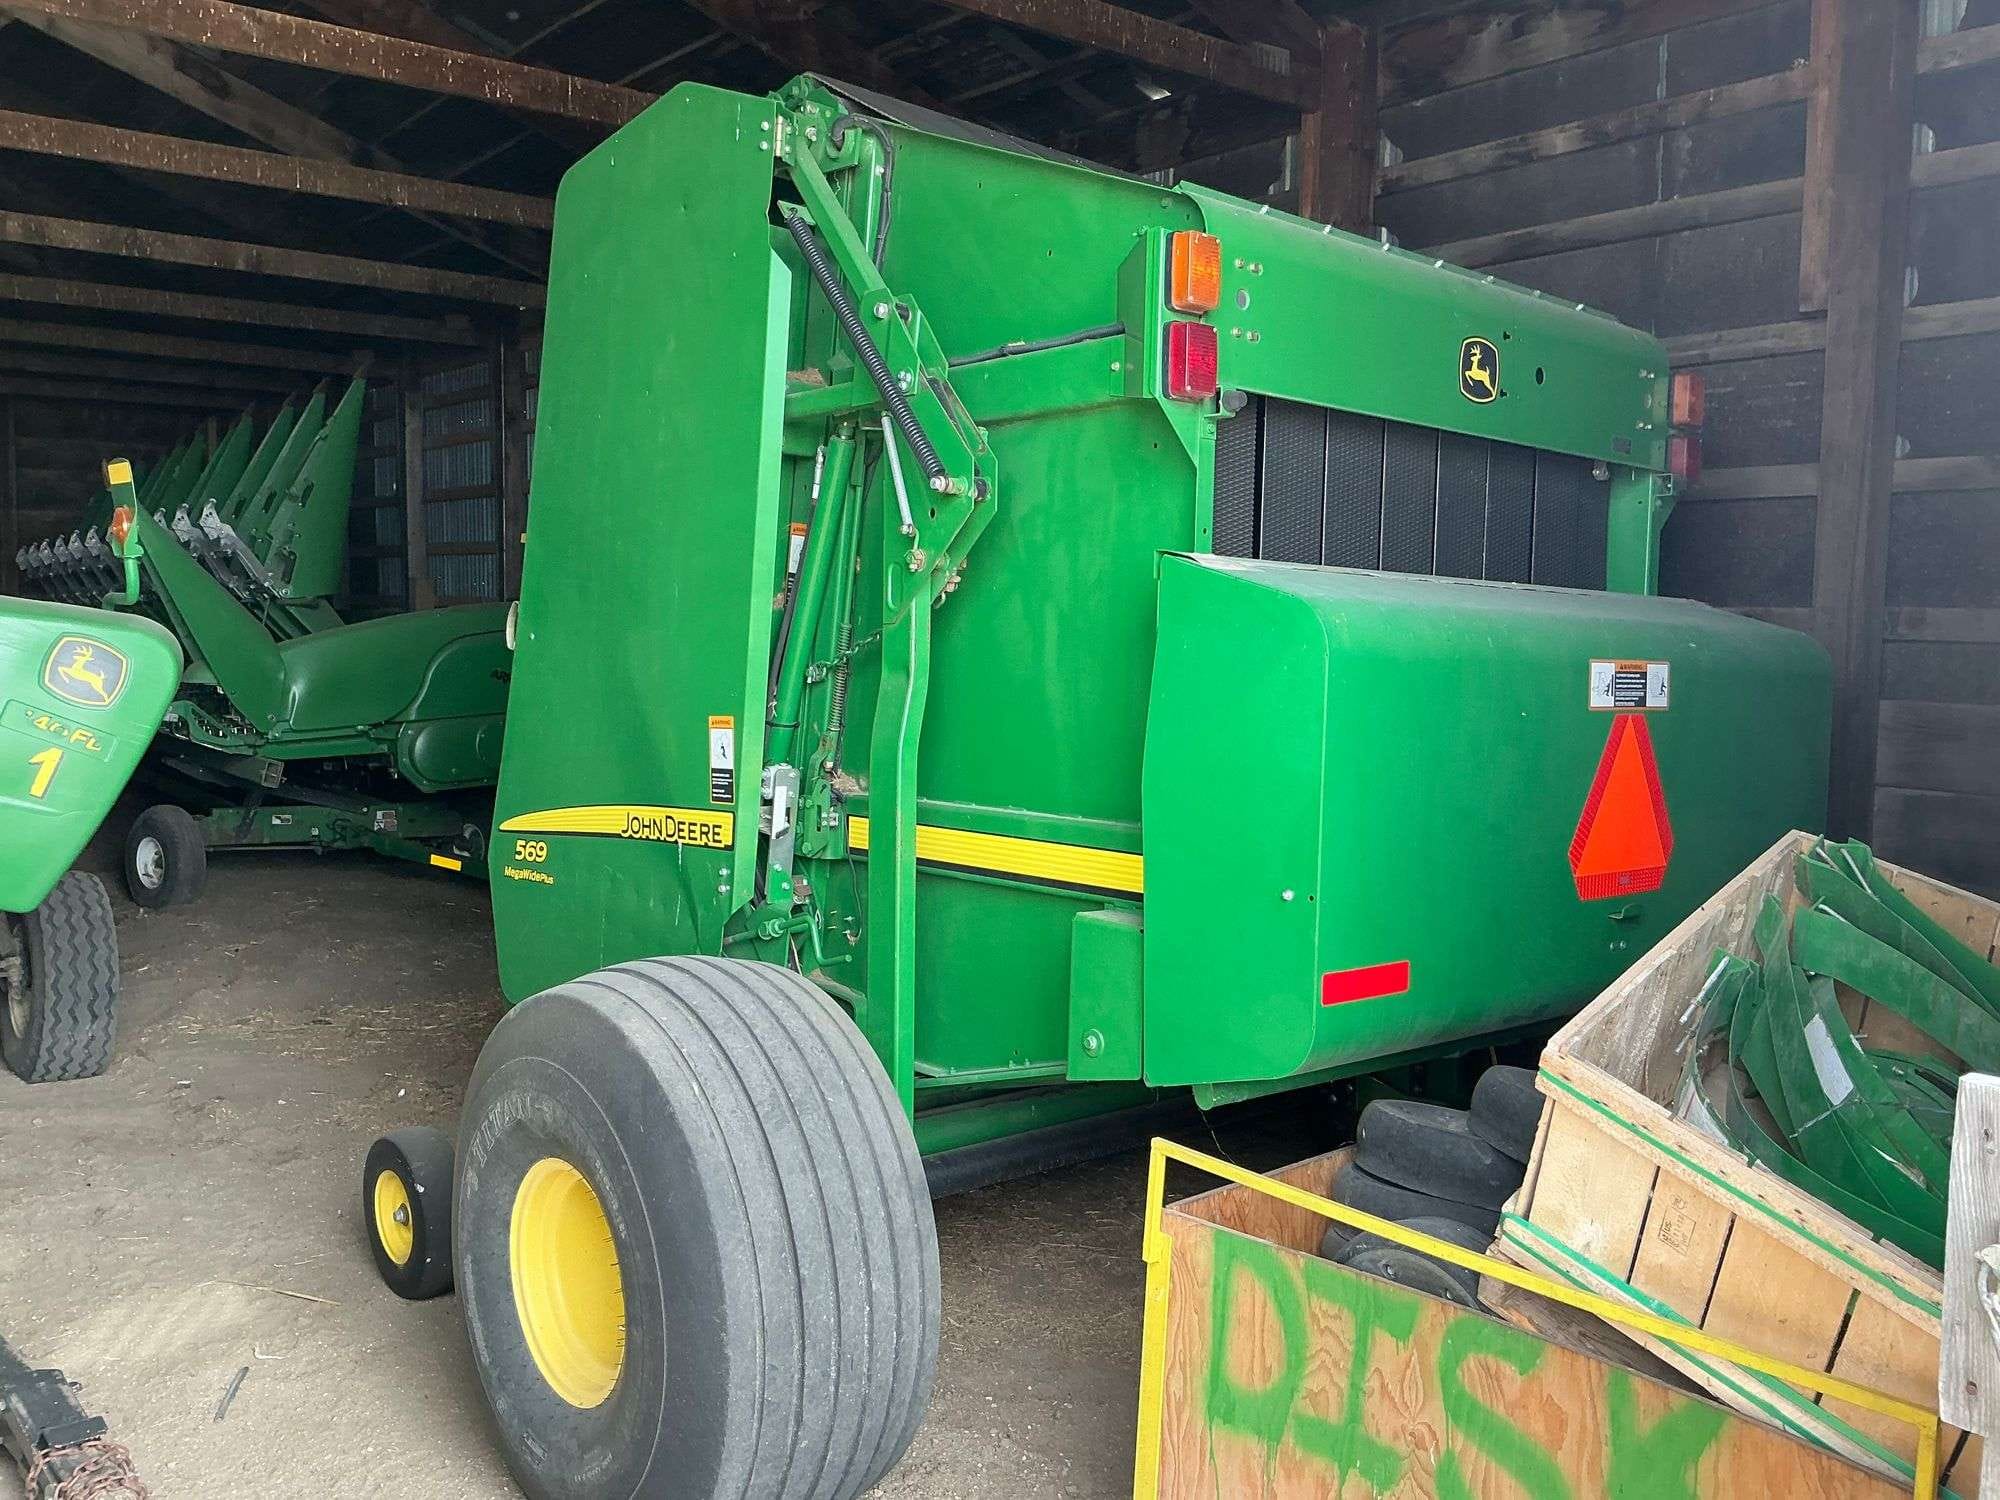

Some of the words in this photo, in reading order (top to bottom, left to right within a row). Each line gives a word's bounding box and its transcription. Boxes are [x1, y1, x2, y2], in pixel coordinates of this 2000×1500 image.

[28, 747, 63, 799] 1
[514, 839, 548, 863] 569
[504, 865, 554, 885] MegaWidePlus
[471, 1094, 532, 1168] TITAN
